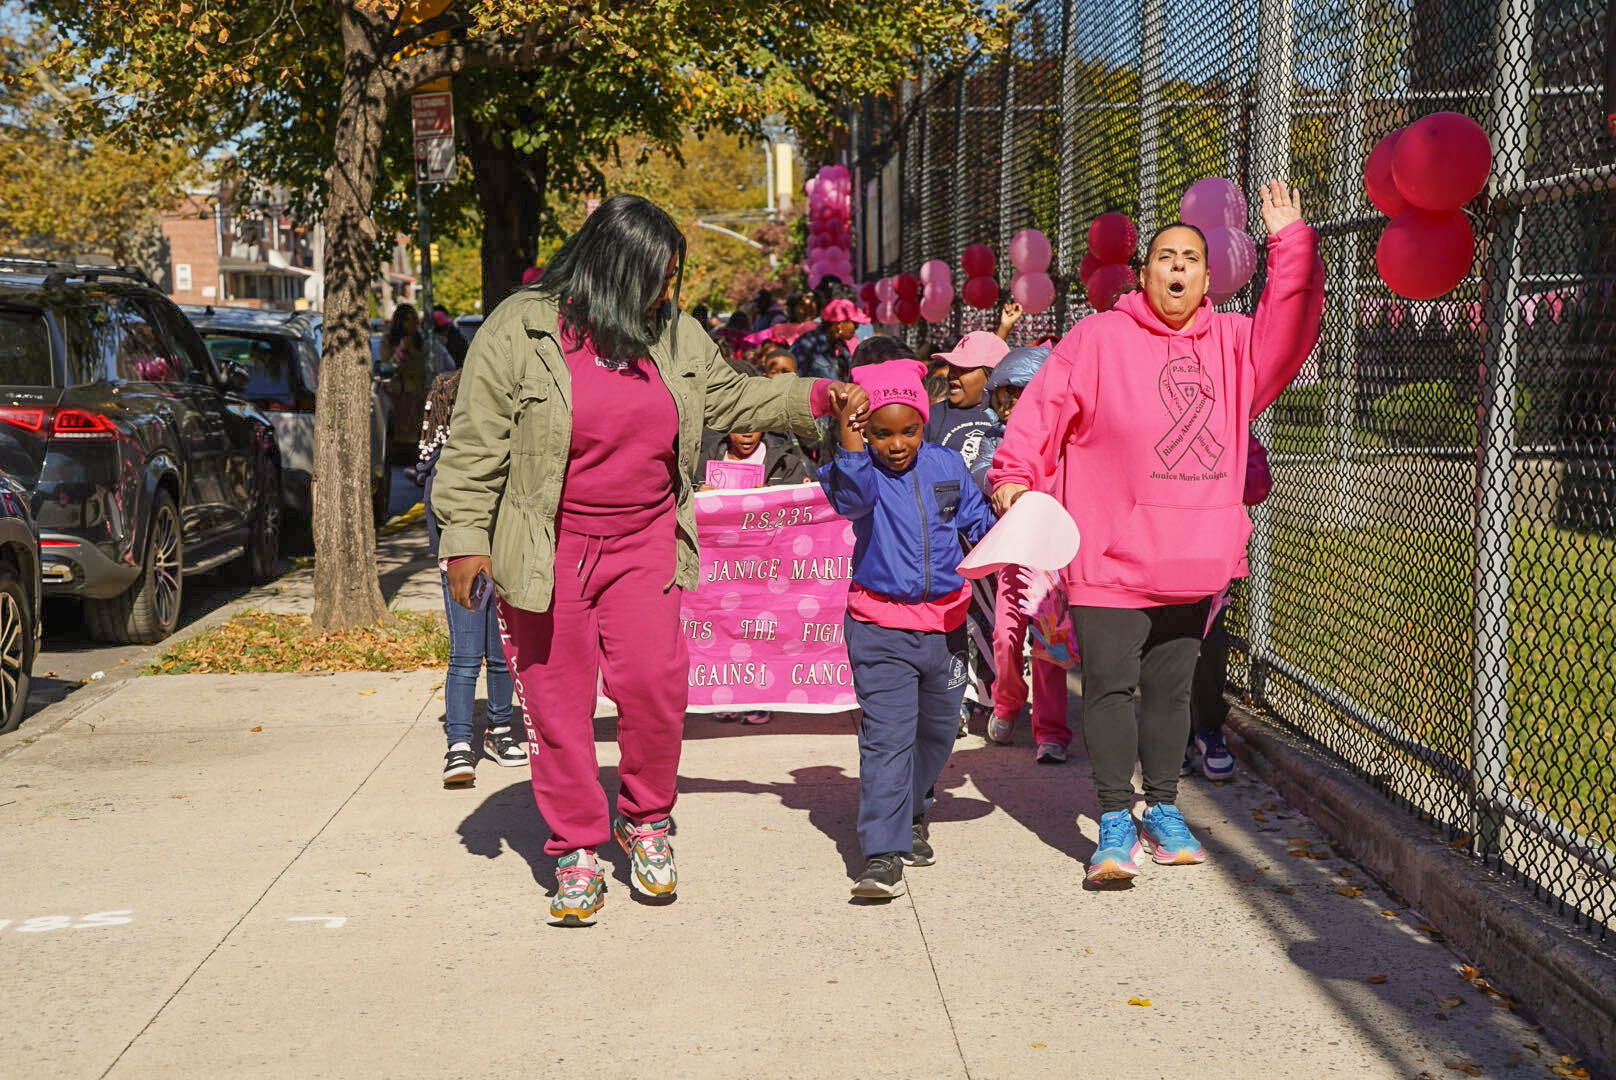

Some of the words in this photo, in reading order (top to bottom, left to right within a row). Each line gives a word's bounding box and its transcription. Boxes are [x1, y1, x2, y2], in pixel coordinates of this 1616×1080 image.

[1162, 435, 1184, 457] Rising
[1150, 471, 1178, 481] Janice
[1179, 473, 1201, 482] Marie
[1202, 471, 1228, 480] Knight
[741, 505, 815, 531] P.S.235
[707, 557, 781, 582] JANICE
[740, 619, 779, 641] THE
[510, 655, 541, 756] WONDER
